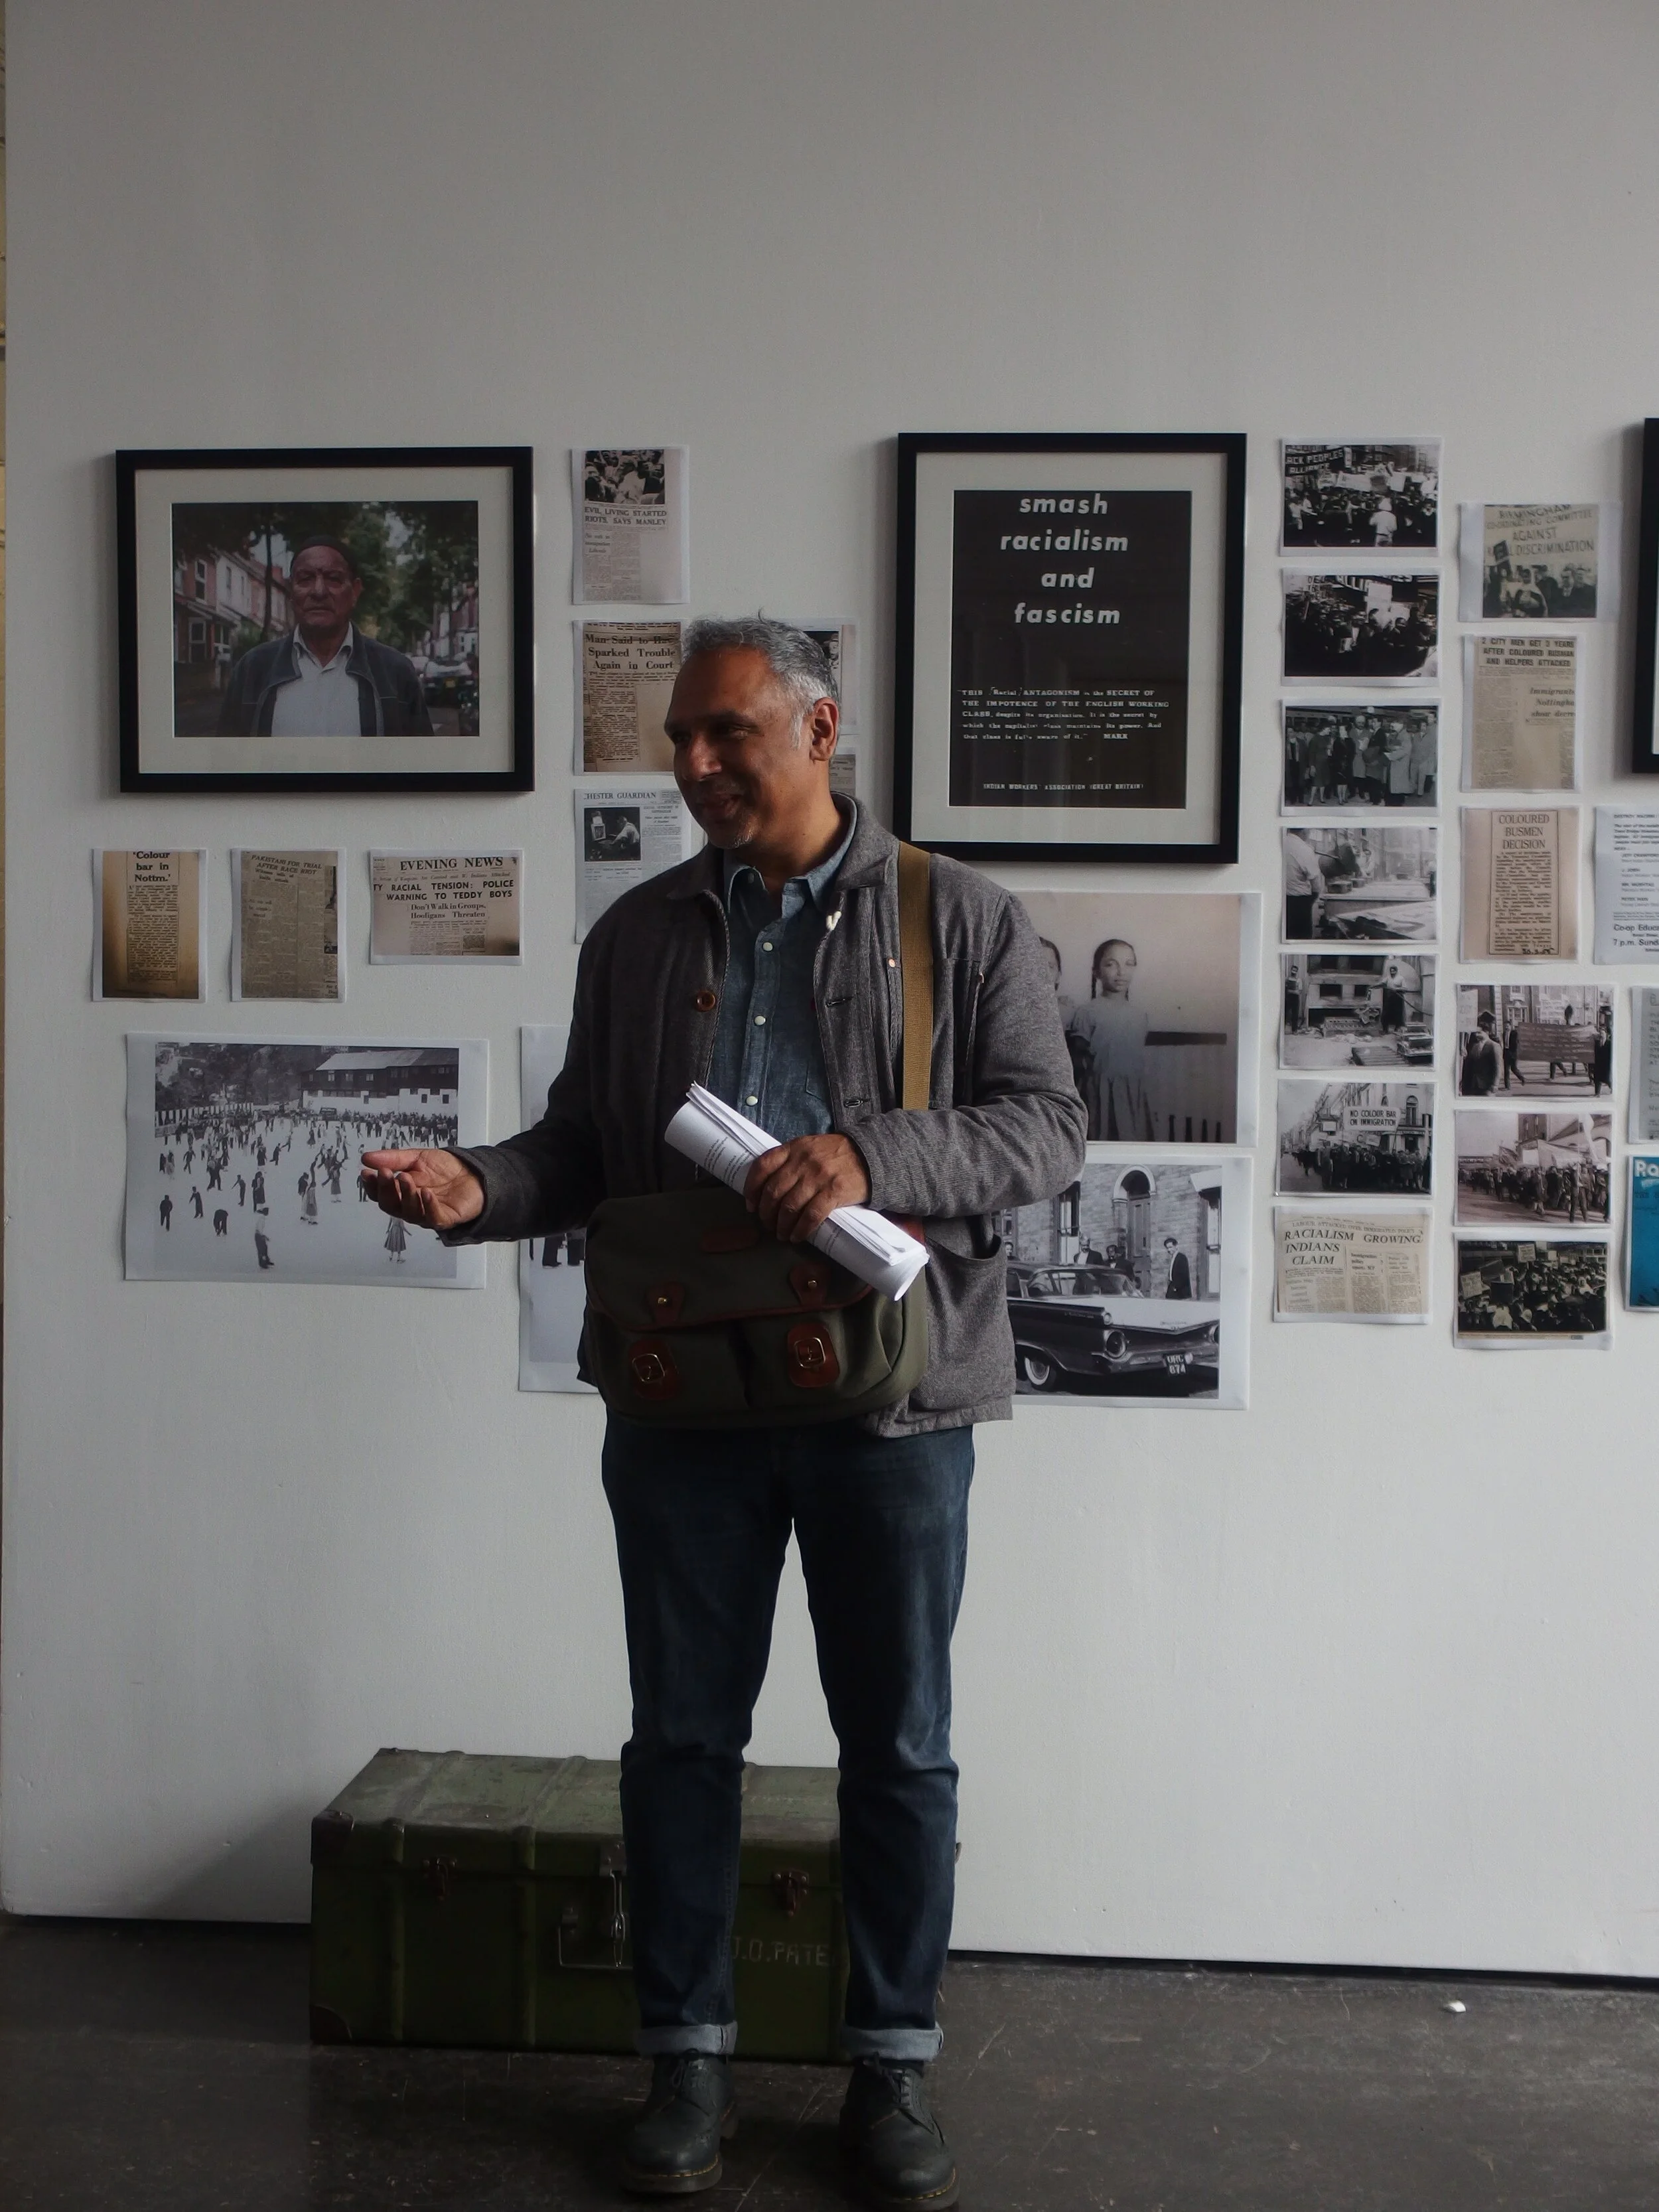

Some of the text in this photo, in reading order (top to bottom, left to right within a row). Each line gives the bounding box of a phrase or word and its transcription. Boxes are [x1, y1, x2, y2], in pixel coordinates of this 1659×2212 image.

[1019, 493, 1108, 514] smash
[1001, 528, 1127, 551] racialism
[1512, 526, 1556, 541] AGAINST
[1516, 540, 1595, 556] DISCRIMINATION
[1041, 567, 1094, 588] and
[1015, 602, 1119, 624] fascism
[585, 634, 606, 643] Man
[612, 635, 632, 644] Said
[589, 647, 676, 659] Sparked Trouble
[593, 661, 620, 671] Again
[646, 661, 673, 670] Court
[1498, 814, 1550, 824] COLOURED
[1505, 826, 1543, 837] BUSMEN
[1502, 839, 1546, 849] DECISION
[399, 858, 458, 871] EVENING
[465, 857, 504, 868] NEWS
[431, 881, 472, 890] TENSION:
[1284, 1228, 1354, 1242] RACIALISM
[1285, 1242, 1340, 1254] INDIANS
[1291, 1255, 1334, 1266] CLAIM
